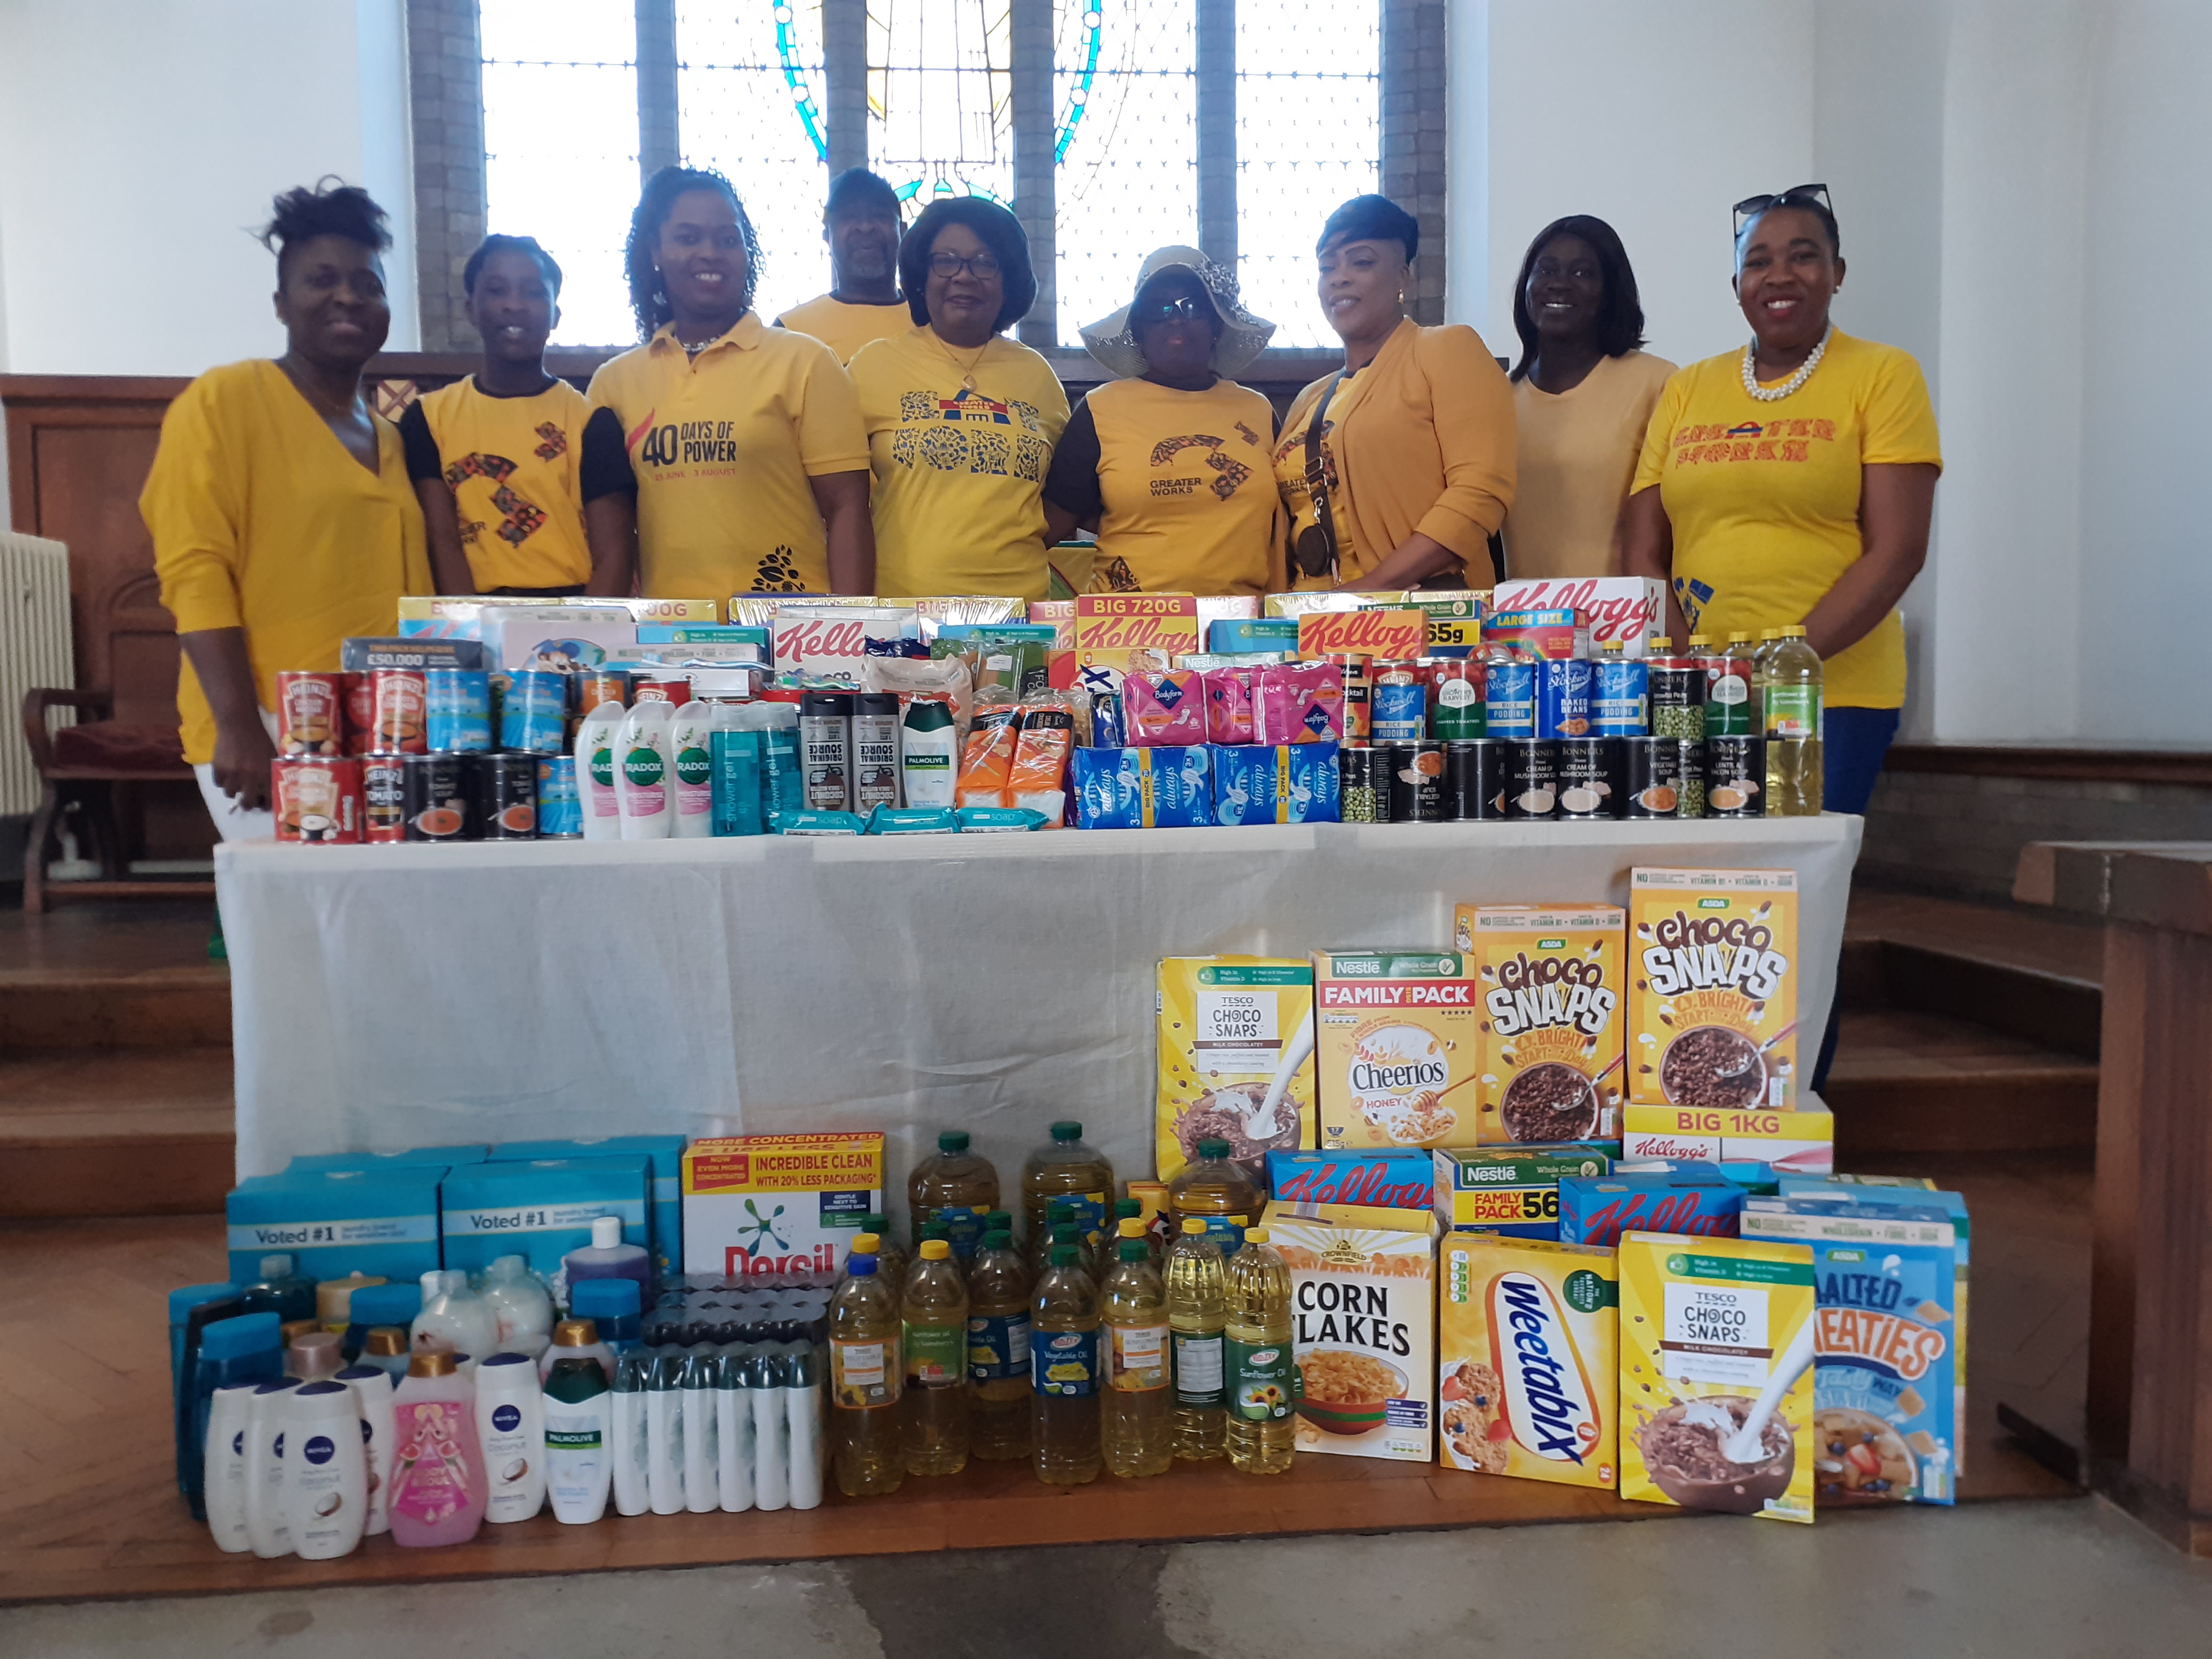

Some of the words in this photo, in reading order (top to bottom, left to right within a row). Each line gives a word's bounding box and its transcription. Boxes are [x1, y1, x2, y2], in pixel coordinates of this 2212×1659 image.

[681, 421, 713, 440] DAYS
[717, 421, 735, 439] OF
[642, 424, 677, 467] 40
[684, 440, 736, 464] POWER
[665, 470, 686, 479] JUNE
[701, 468, 736, 476] AUGUST
[1150, 477, 1202, 488] GREATER
[1150, 487, 1193, 497] WORKS
[1044, 604, 1074, 618] BIG
[1094, 599, 1126, 614] BIG
[1131, 599, 1181, 614] 720G
[1497, 614, 1533, 626] LARGE
[1537, 612, 1563, 624] SIZE
[1155, 690, 1183, 700] Bodyform
[1373, 691, 1416, 710] Stockwell
[1561, 698, 1588, 706] BAKED
[1493, 710, 1525, 718] PUDDING
[1561, 705, 1588, 714] BEANS
[1601, 707, 1633, 716] PUDDING
[1378, 729, 1408, 737] PUDDING
[809, 744, 842, 754] SOURCE
[860, 745, 893, 755] SOURCE
[810, 754, 842, 762] ORIGINAL
[861, 754, 893, 763] ORIGINAL
[592, 763, 612, 773] RAD
[625, 763, 663, 772] RADOX
[677, 761, 710, 771] RADOX
[1162, 766, 1179, 810] always
[1250, 765, 1268, 806] always
[1313, 761, 1331, 804] always
[1098, 768, 1115, 812] always
[817, 816, 842, 824] soap
[991, 813, 1015, 822] soap
[1636, 873, 1648, 882] NO
[1480, 917, 1491, 926] NO
[1656, 911, 1772, 952] choco
[1336, 961, 1380, 974] Nestlé
[1499, 952, 1603, 990] choco
[1642, 943, 1788, 999] SNAPS
[1325, 987, 1404, 1004] FAMILY
[1413, 986, 1469, 1003] PACK
[1698, 991, 1748, 1011] BRIGHT
[1213, 1010, 1261, 1023] CHOCO
[1486, 983, 1617, 1036] SNAPS
[1215, 1024, 1257, 1037] SNAPS
[1536, 1029, 1583, 1047] BRIGHT
[1515, 1046, 1549, 1068] START
[1352, 1062, 1444, 1090] Cheerios
[1366, 1098, 1402, 1109] HONEY
[1678, 1112, 1721, 1131] BIG
[1730, 1116, 1780, 1134] 1KG
[749, 1133, 880, 1145] CONCENTRATED
[1635, 1138, 1709, 1160] Kellogg's
[756, 1156, 828, 1171] INCREDIBLE
[832, 1154, 872, 1169] CLEAN
[756, 1176, 779, 1186] WITH
[781, 1176, 799, 1186] 20%
[801, 1175, 821, 1186] LESS
[1467, 1166, 1516, 1182] Nestlé
[1560, 1165, 1579, 1174] Grain
[1475, 1192, 1522, 1205] FAMILY
[1523, 1191, 1559, 1219] 56
[1475, 1205, 1522, 1219] PACK
[470, 1213, 521, 1230] Voted
[525, 1210, 547, 1227] #1
[256, 1228, 308, 1245] Voted
[312, 1225, 335, 1242] #1
[1321, 1249, 1367, 1261] CROWNFIELD
[1695, 1291, 1737, 1303] TESCO
[1814, 1272, 1903, 1311] ALTED
[1298, 1281, 1388, 1317] CORN
[1684, 1306, 1746, 1325] CHOCO
[1292, 1314, 1410, 1356] LAKES
[1688, 1323, 1740, 1342] SNAPS
[1044, 1350, 1077, 1362] Vegetable
[1239, 1367, 1276, 1379] Sunflower
[549, 1433, 594, 1442] PALMOLIVE
